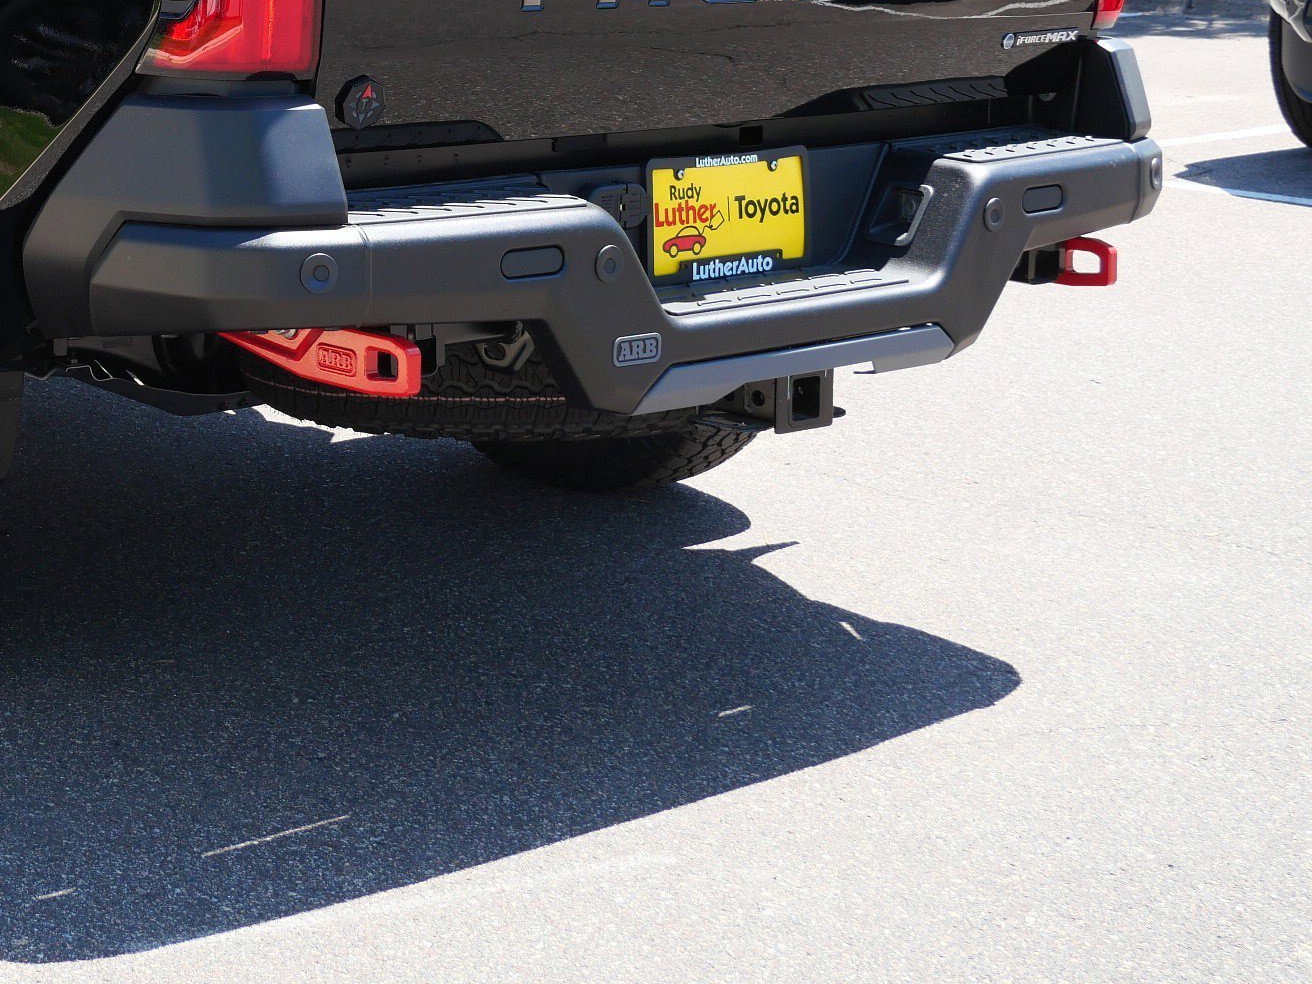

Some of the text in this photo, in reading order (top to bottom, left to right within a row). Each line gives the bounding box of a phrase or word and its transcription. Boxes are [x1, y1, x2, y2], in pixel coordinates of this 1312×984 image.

[695, 154, 758, 168] LutherAuto.com
[669, 183, 702, 203] Rudy
[654, 200, 717, 228] Luther
[734, 192, 800, 223] Toyota
[692, 255, 773, 281] LutherAuto
[319, 348, 354, 369] ARB
[618, 338, 657, 362] ARB
